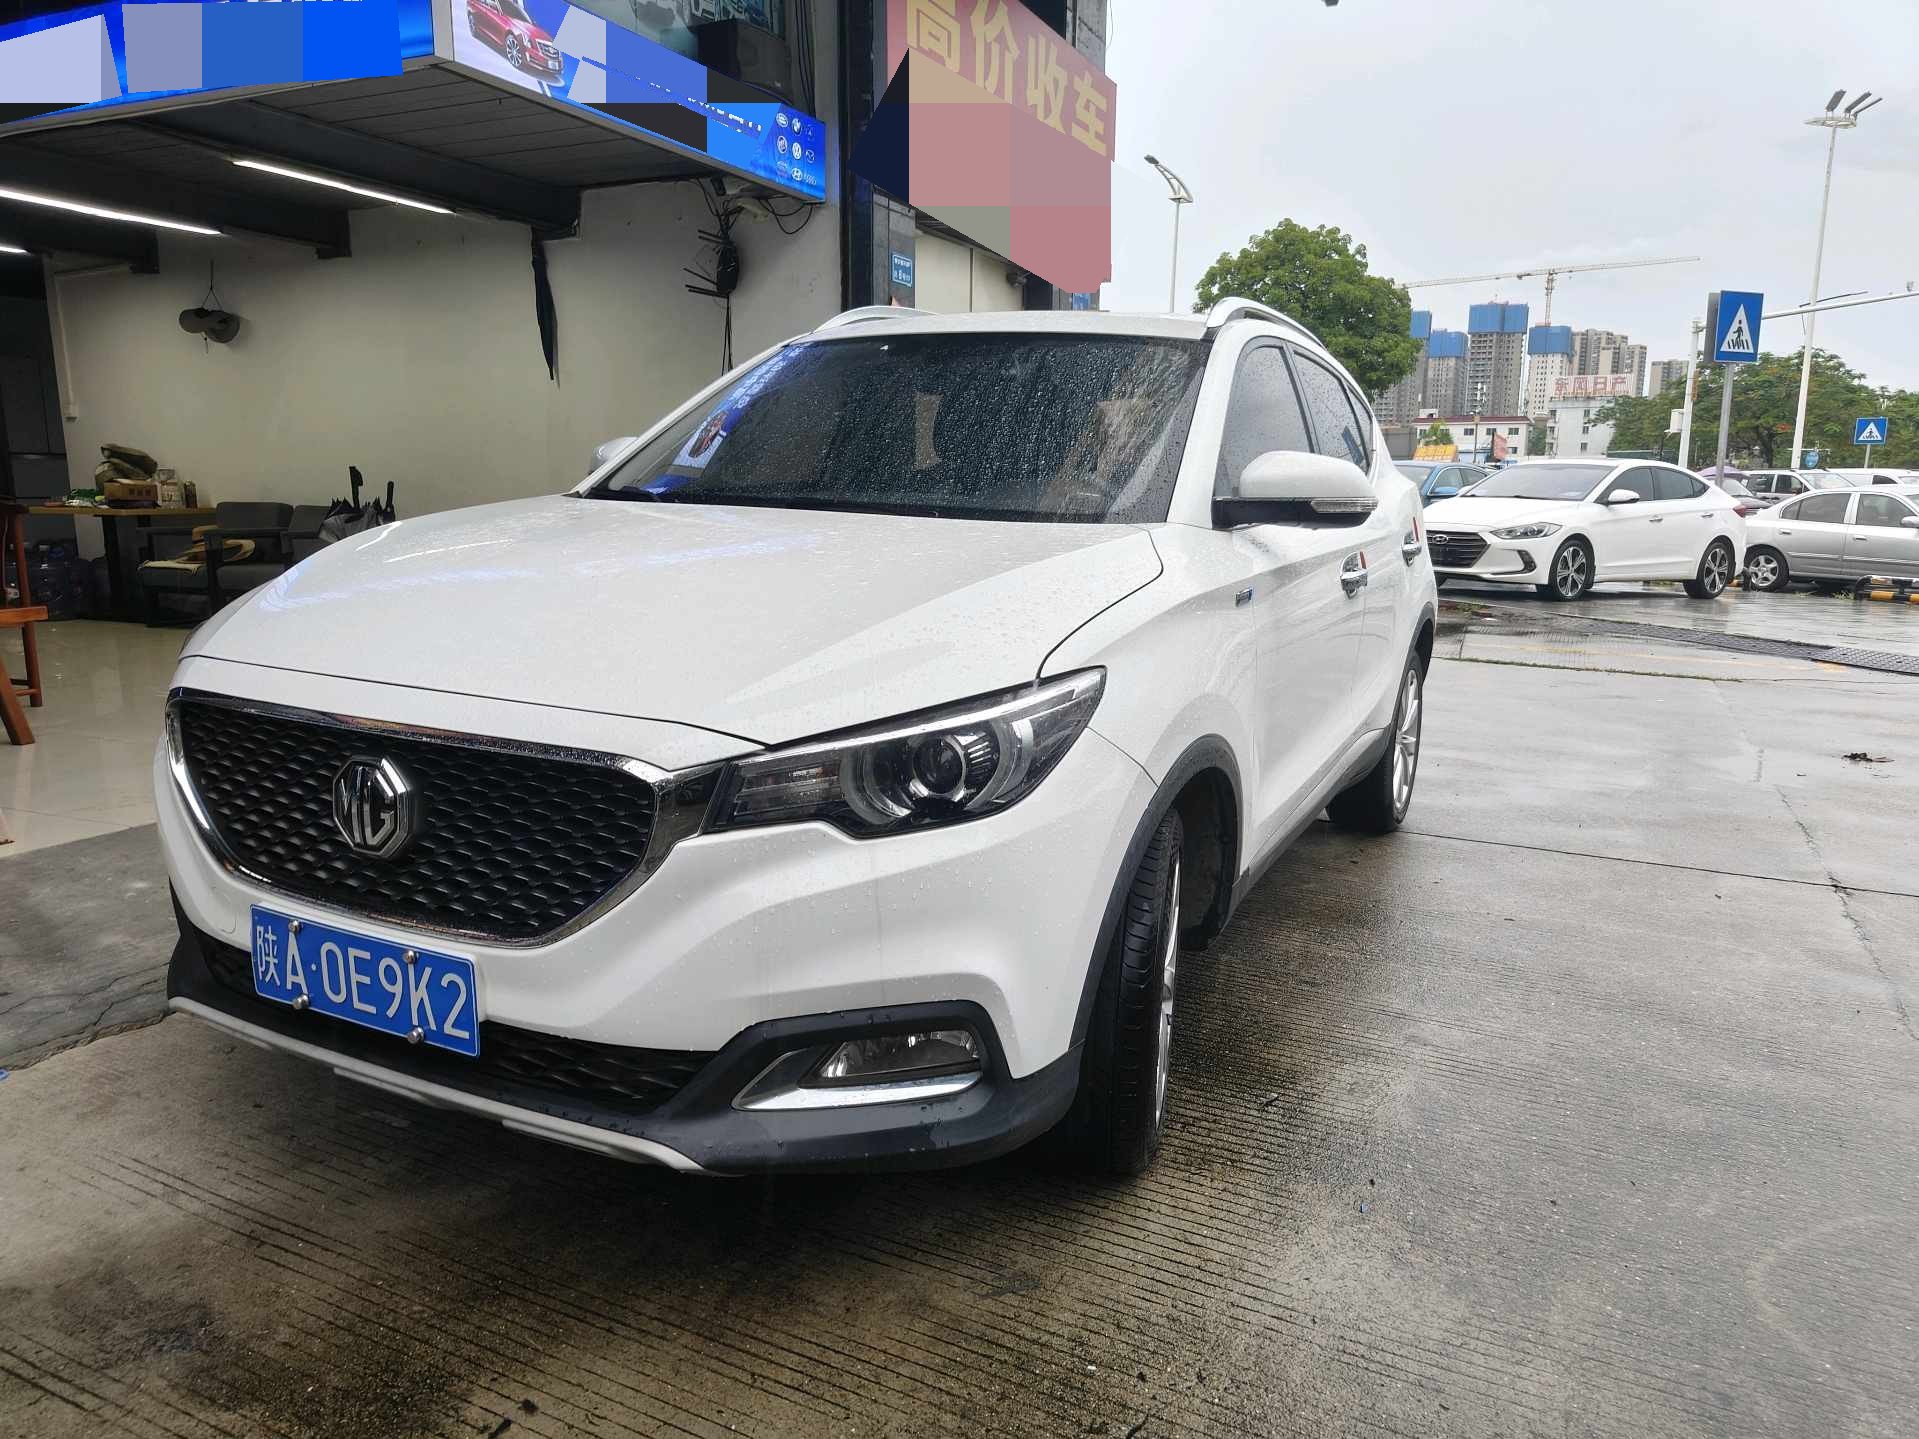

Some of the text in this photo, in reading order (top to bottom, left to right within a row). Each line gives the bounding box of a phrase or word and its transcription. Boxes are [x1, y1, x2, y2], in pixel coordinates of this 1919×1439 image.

[907, 0, 1108, 157] 高价收车
[340, 765, 396, 846] MG
